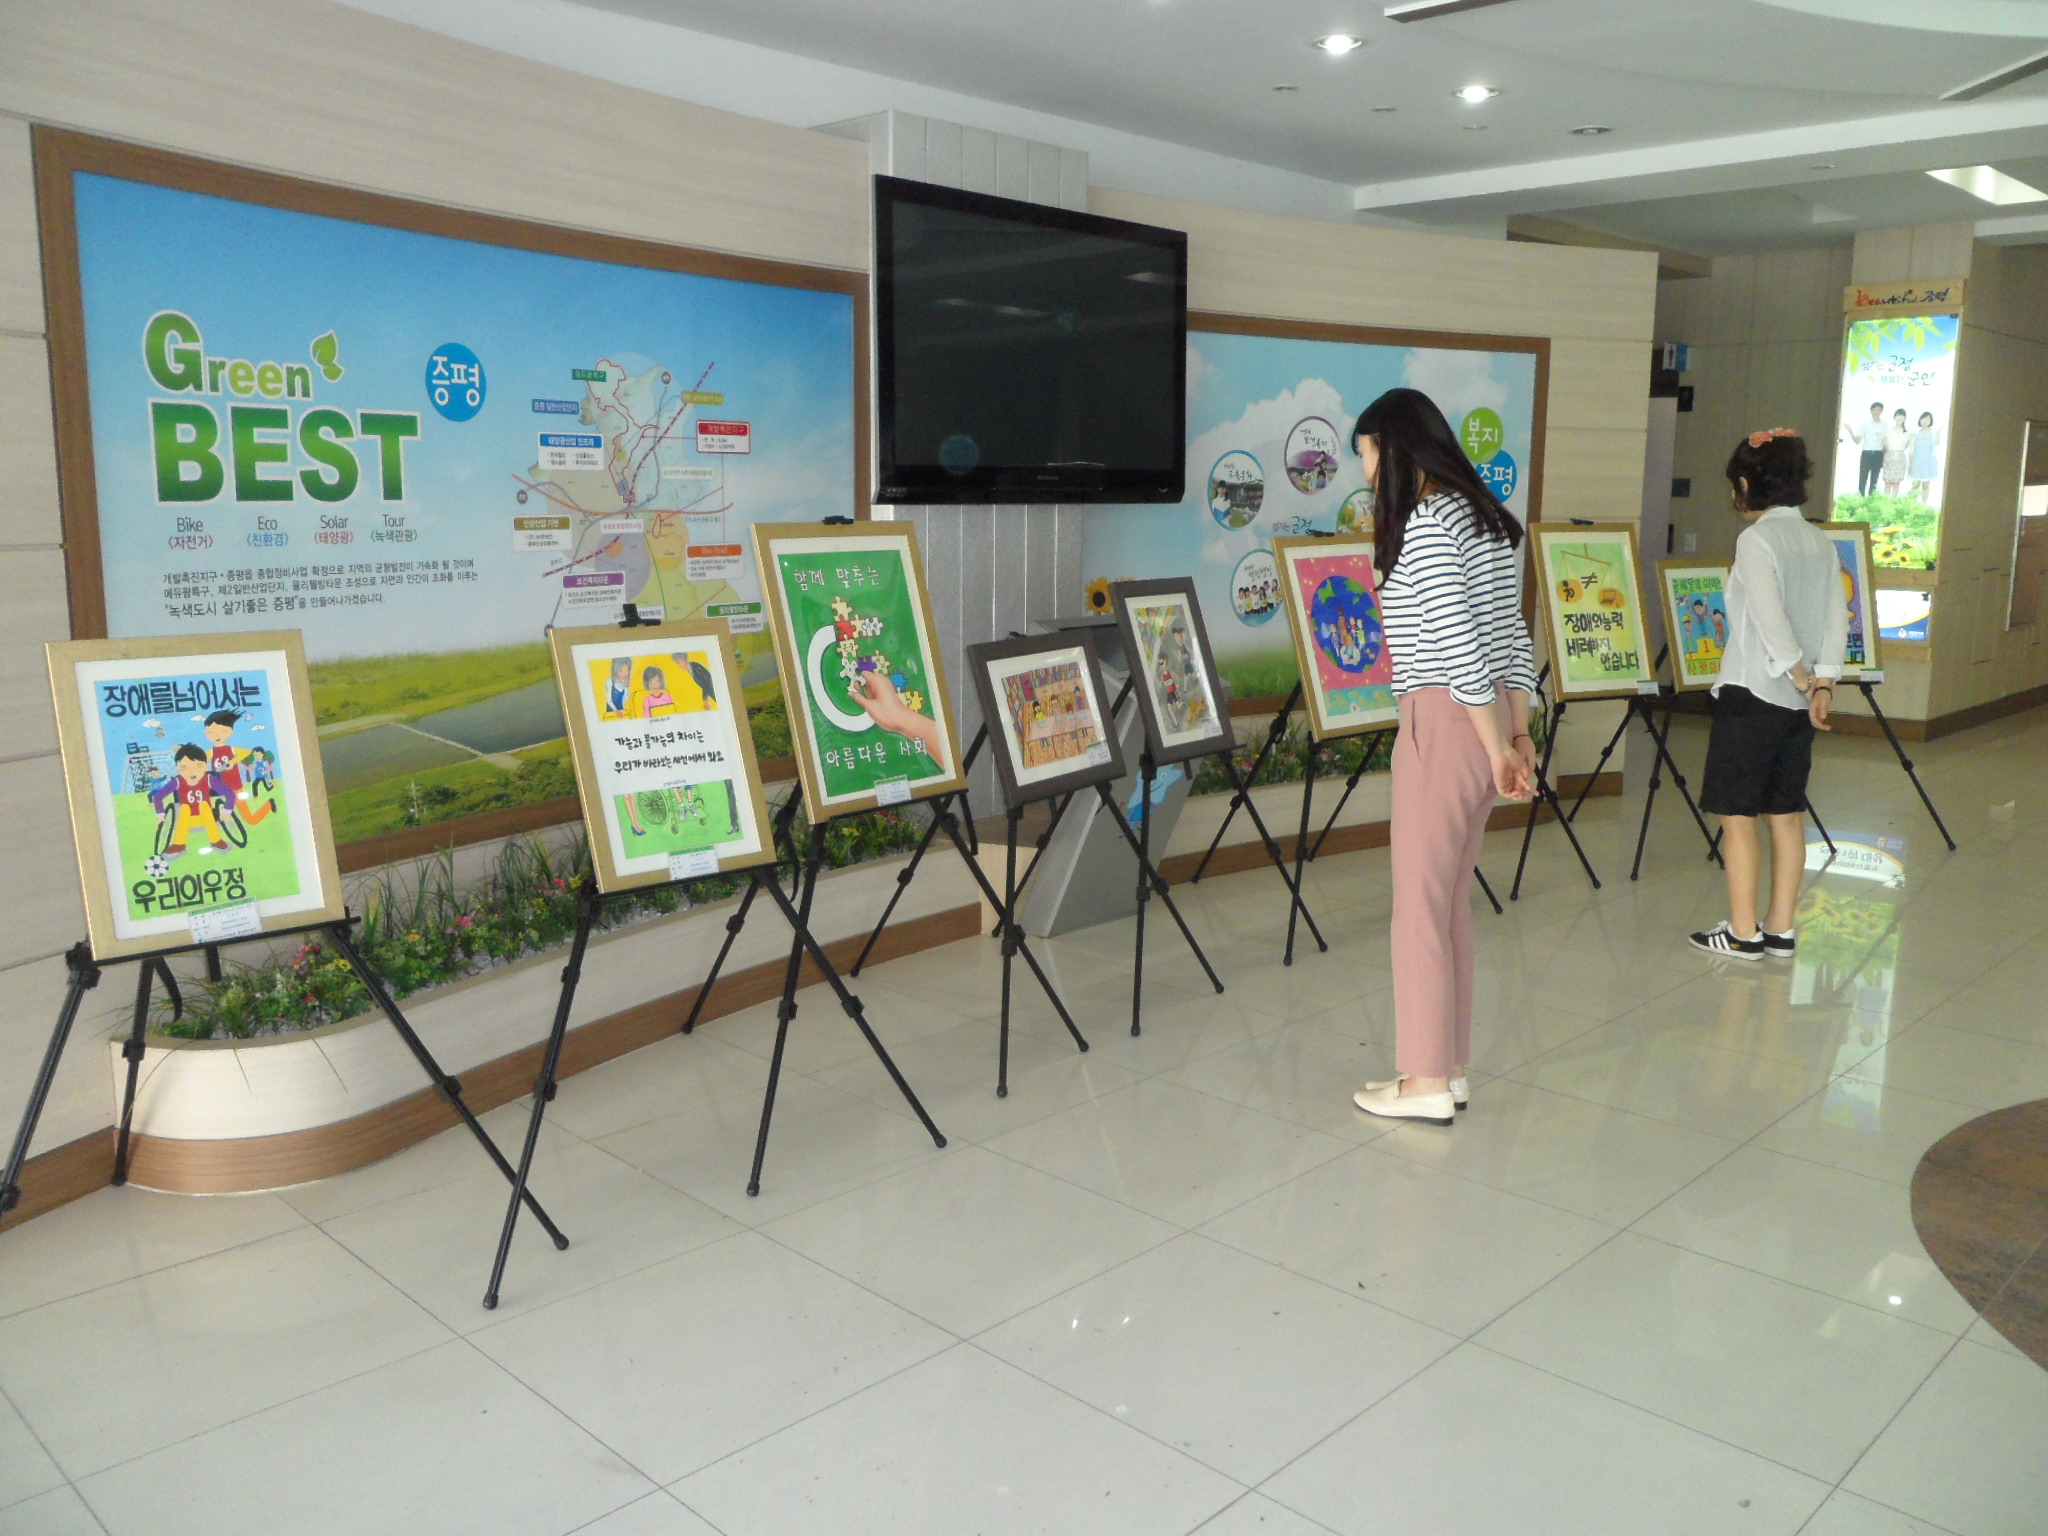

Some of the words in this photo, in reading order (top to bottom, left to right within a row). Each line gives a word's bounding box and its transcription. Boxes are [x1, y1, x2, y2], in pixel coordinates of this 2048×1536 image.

[143, 310, 312, 398] Green
[431, 354, 482, 407] 증평
[1467, 417, 1499, 456] 복지
[148, 398, 420, 503] BEST
[176, 516, 204, 532] Bike
[257, 515, 278, 531] Eco
[320, 514, 349, 529] Solar
[382, 514, 405, 528] Tour
[163, 570, 217, 585] 개발촉진지구
[226, 569, 252, 582] 증평읍
[257, 566, 308, 579] 종합정비사업
[312, 565, 344, 577] 확정으로
[348, 563, 372, 575] 지역의
[375, 561, 413, 573] 균형발전이
[417, 560, 439, 571] 가속화
[452, 558, 474, 569] 것이며
[292, 578, 342, 591] 율리웰빙타운
[345, 576, 377, 588] 조성으로
[380, 575, 403, 586] 자연과
[406, 573, 429, 584] 인간이
[432, 572, 454, 583] 조화를
[457, 570, 479, 581] 이루는
[793, 568, 825, 591] 함께
[836, 566, 879, 589] 맞추는
[222, 597, 268, 615] 살기좋은
[1563, 611, 1624, 634] 장애와능력
[1566, 636, 1611, 659] 비례하지
[103, 677, 262, 718] 장애를넘어서는
[615, 737, 642, 750] 가능과
[644, 731, 675, 749] 불가능의
[677, 730, 704, 743] 차이는
[614, 760, 641, 775] 우리가
[643, 756, 672, 768] 바라보는
[673, 752, 706, 765] 시선에서
[707, 750, 725, 762] 와요
[826, 742, 886, 769] 아름다운
[900, 737, 928, 757] 사회
[187, 789, 204, 804] 69
[132, 867, 247, 913] 우리의우정
